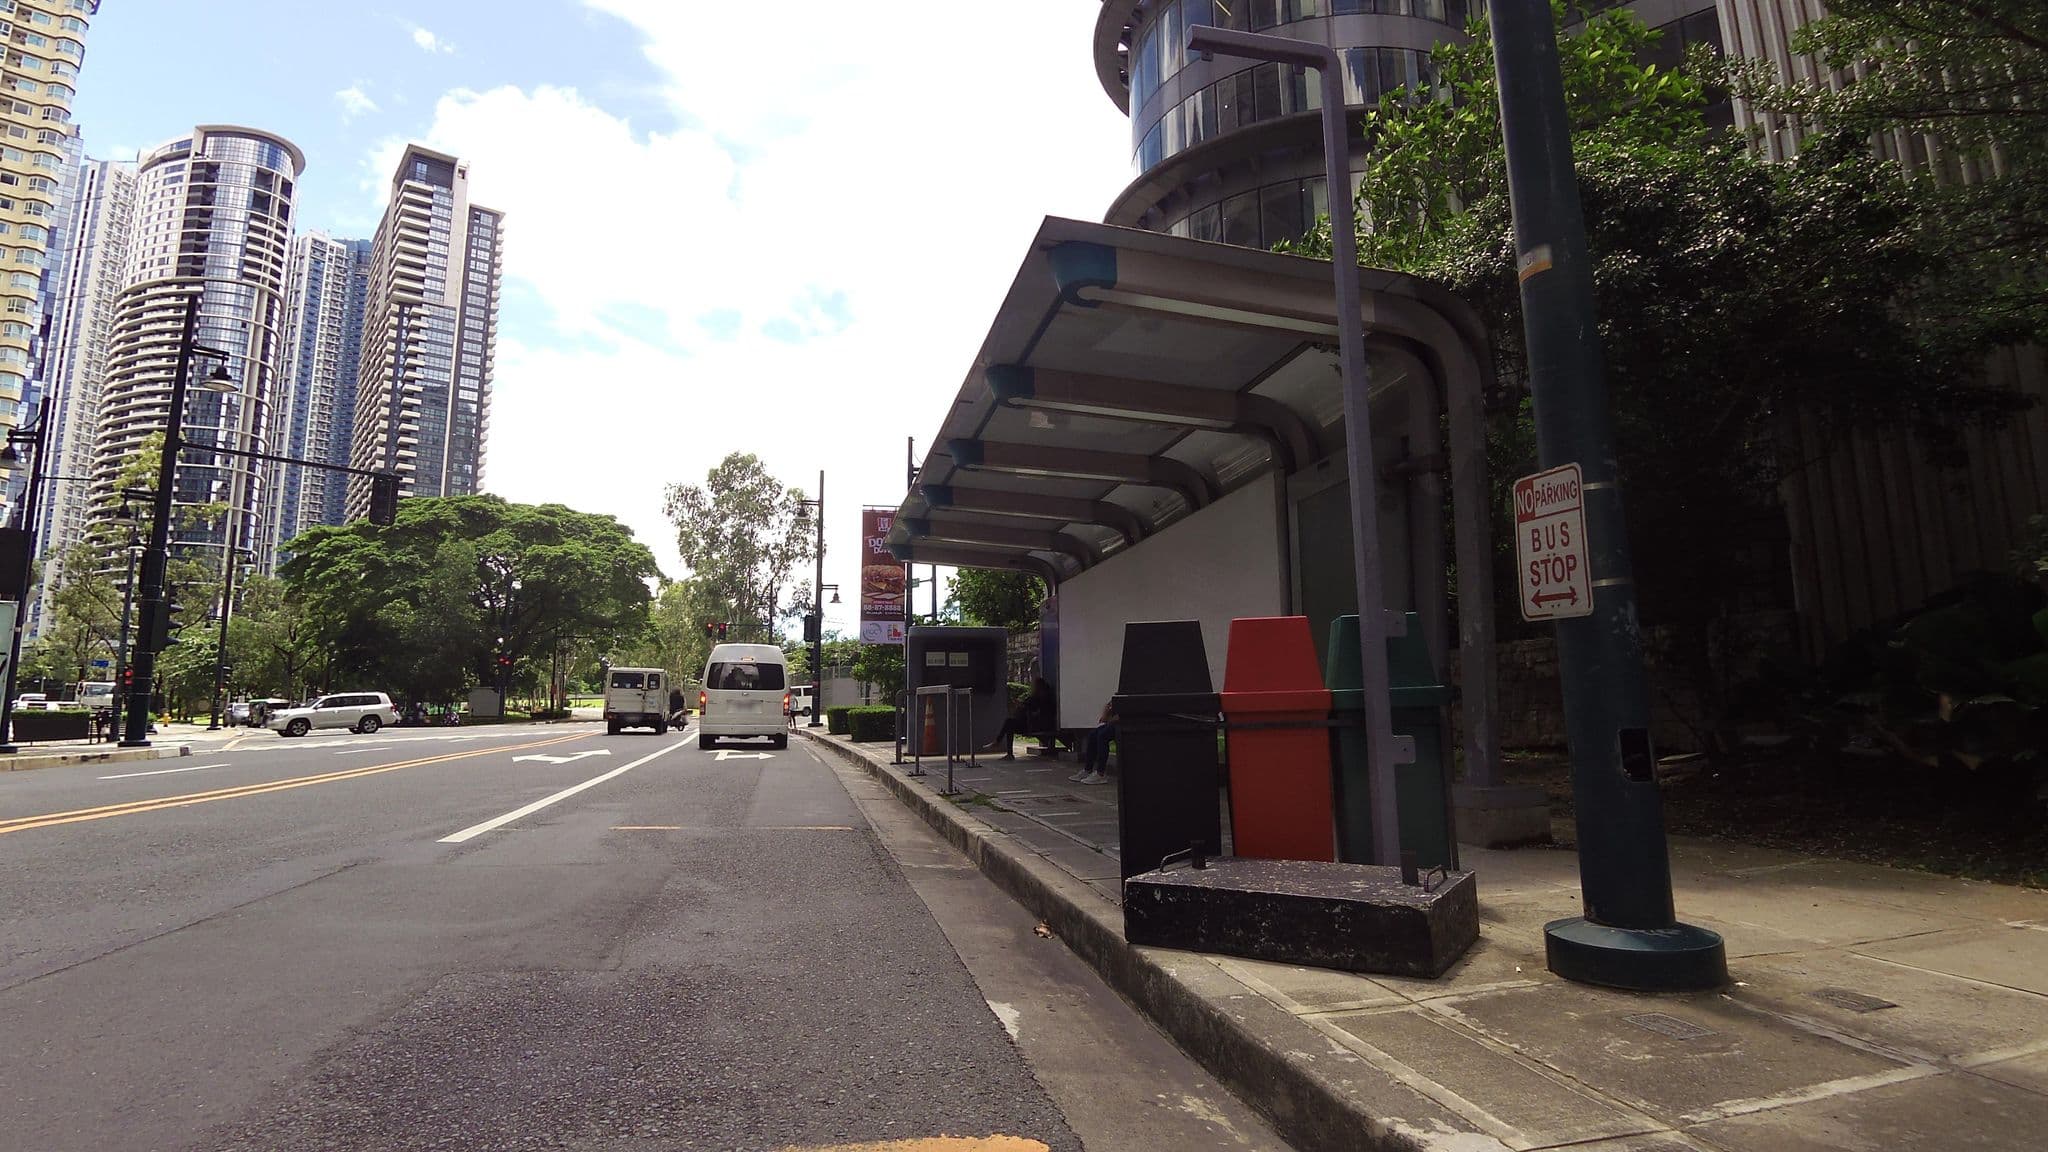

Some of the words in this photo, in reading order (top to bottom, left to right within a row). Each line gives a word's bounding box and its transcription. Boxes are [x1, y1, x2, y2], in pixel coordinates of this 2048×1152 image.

[1516, 488, 1534, 515] NO
[1535, 480, 1578, 508] PARKING
[1531, 521, 1571, 552] BUS
[1530, 554, 1577, 587] STOP
